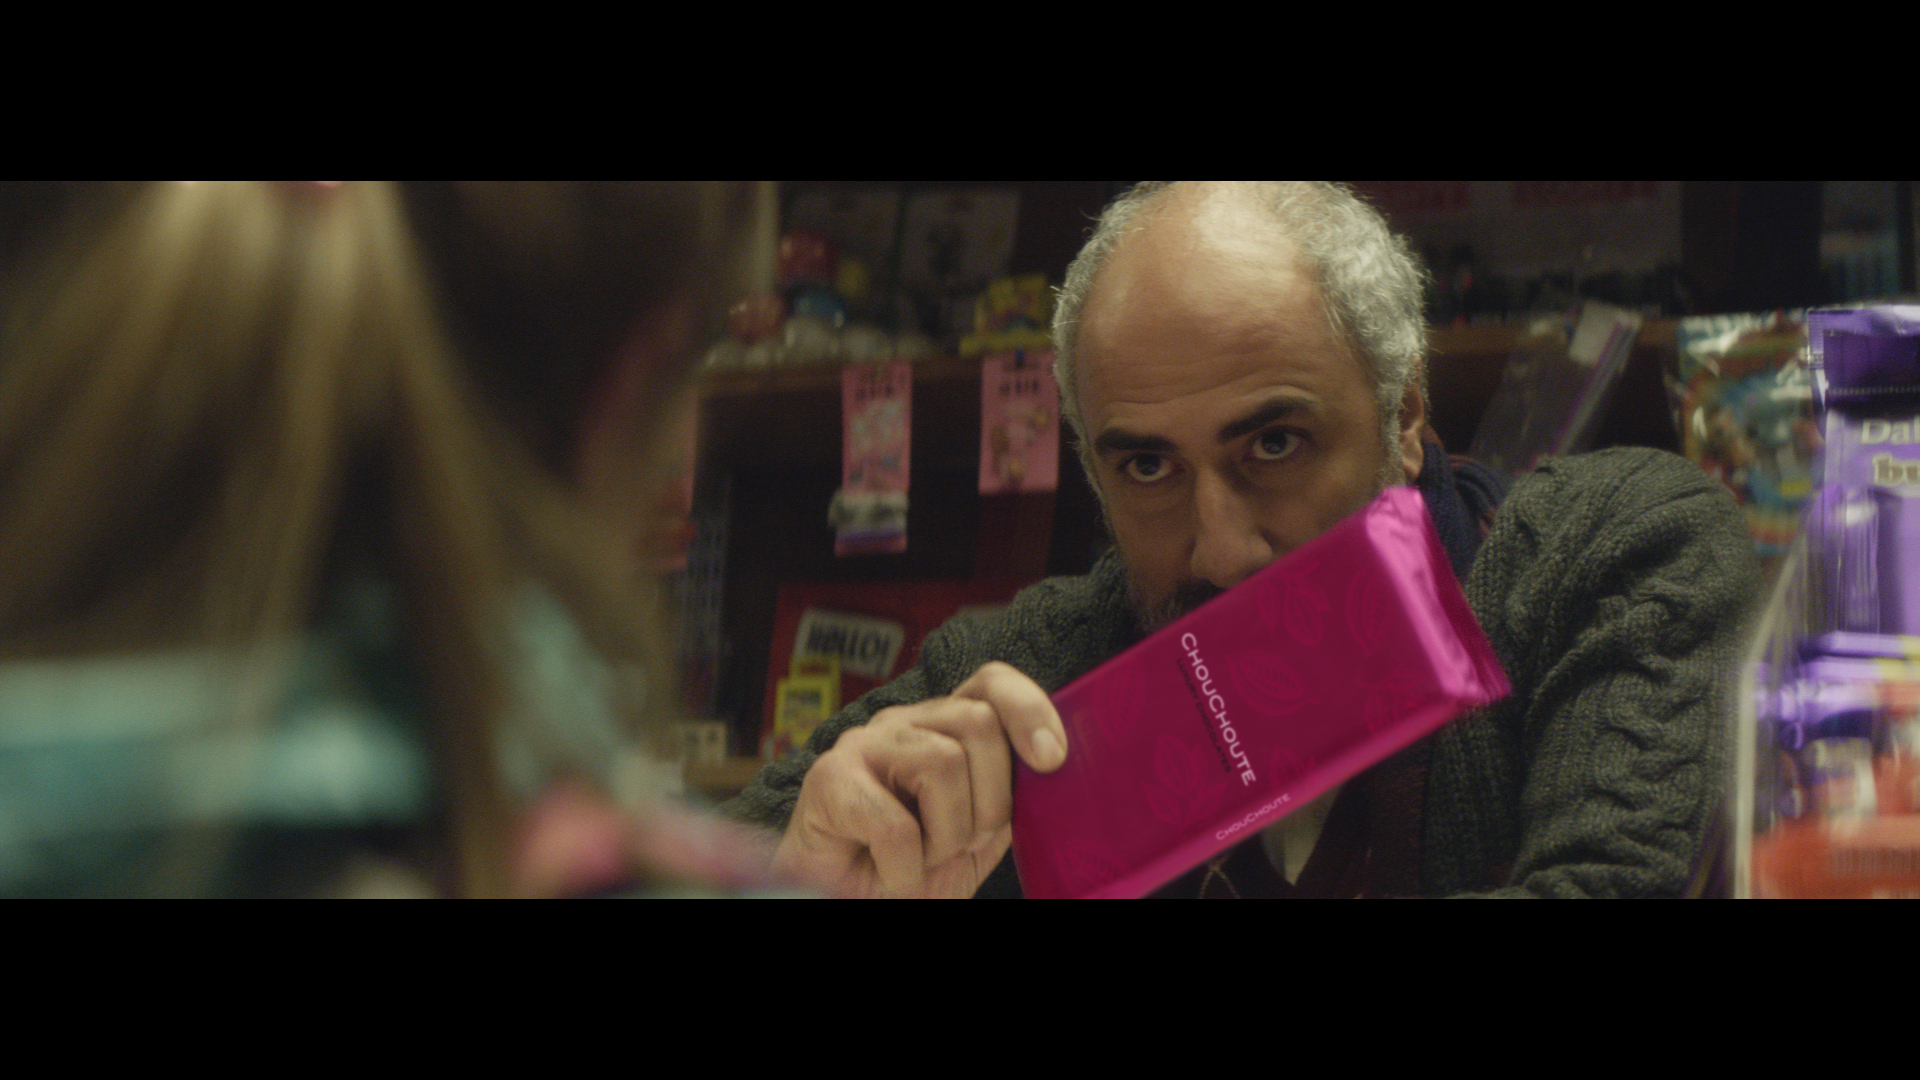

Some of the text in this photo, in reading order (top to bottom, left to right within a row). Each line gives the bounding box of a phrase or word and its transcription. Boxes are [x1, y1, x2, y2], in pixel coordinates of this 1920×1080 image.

[1176, 658, 1232, 774] LUXURY CHOCOLATES
[1181, 632, 1257, 787] CHOUCHOUTE
[1215, 793, 1291, 841] CHOUCHOUTE
